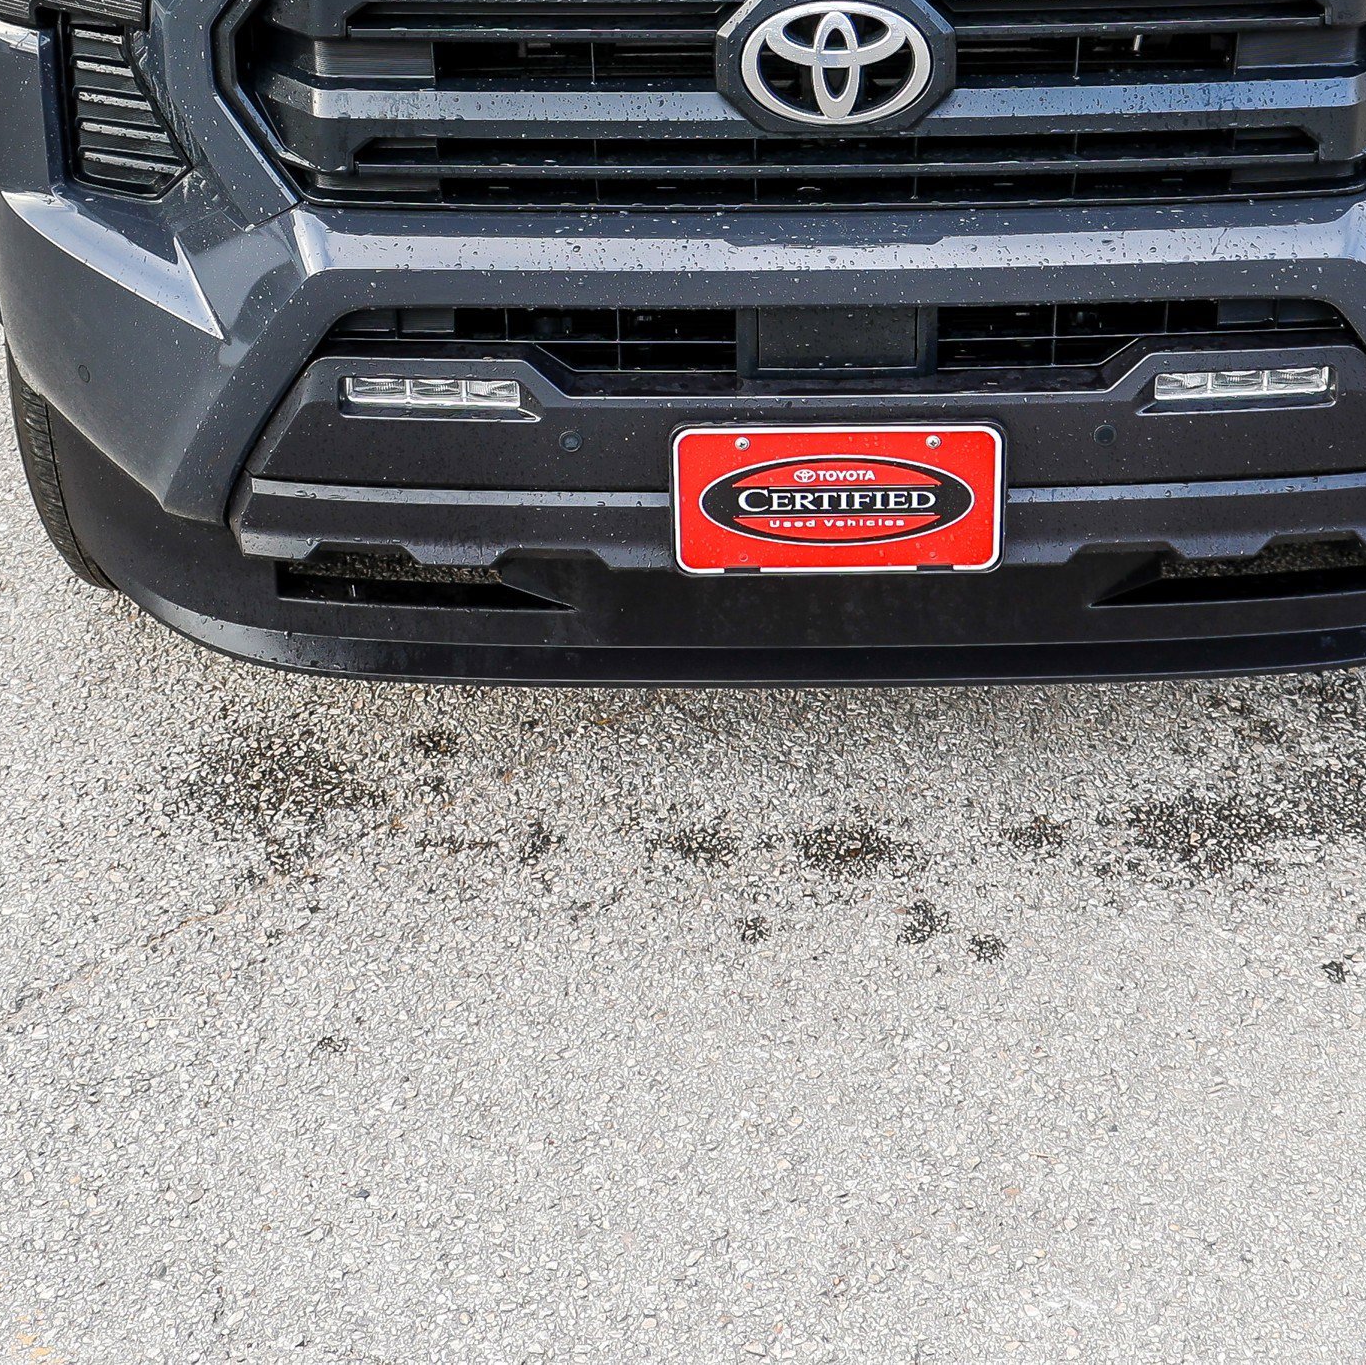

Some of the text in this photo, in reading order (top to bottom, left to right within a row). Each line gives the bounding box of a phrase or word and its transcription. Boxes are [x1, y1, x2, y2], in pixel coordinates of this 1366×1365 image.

[817, 470, 876, 481] TOYOTA
[738, 489, 936, 512] CERTIFIED
[769, 519, 905, 528] Used Vehicles
